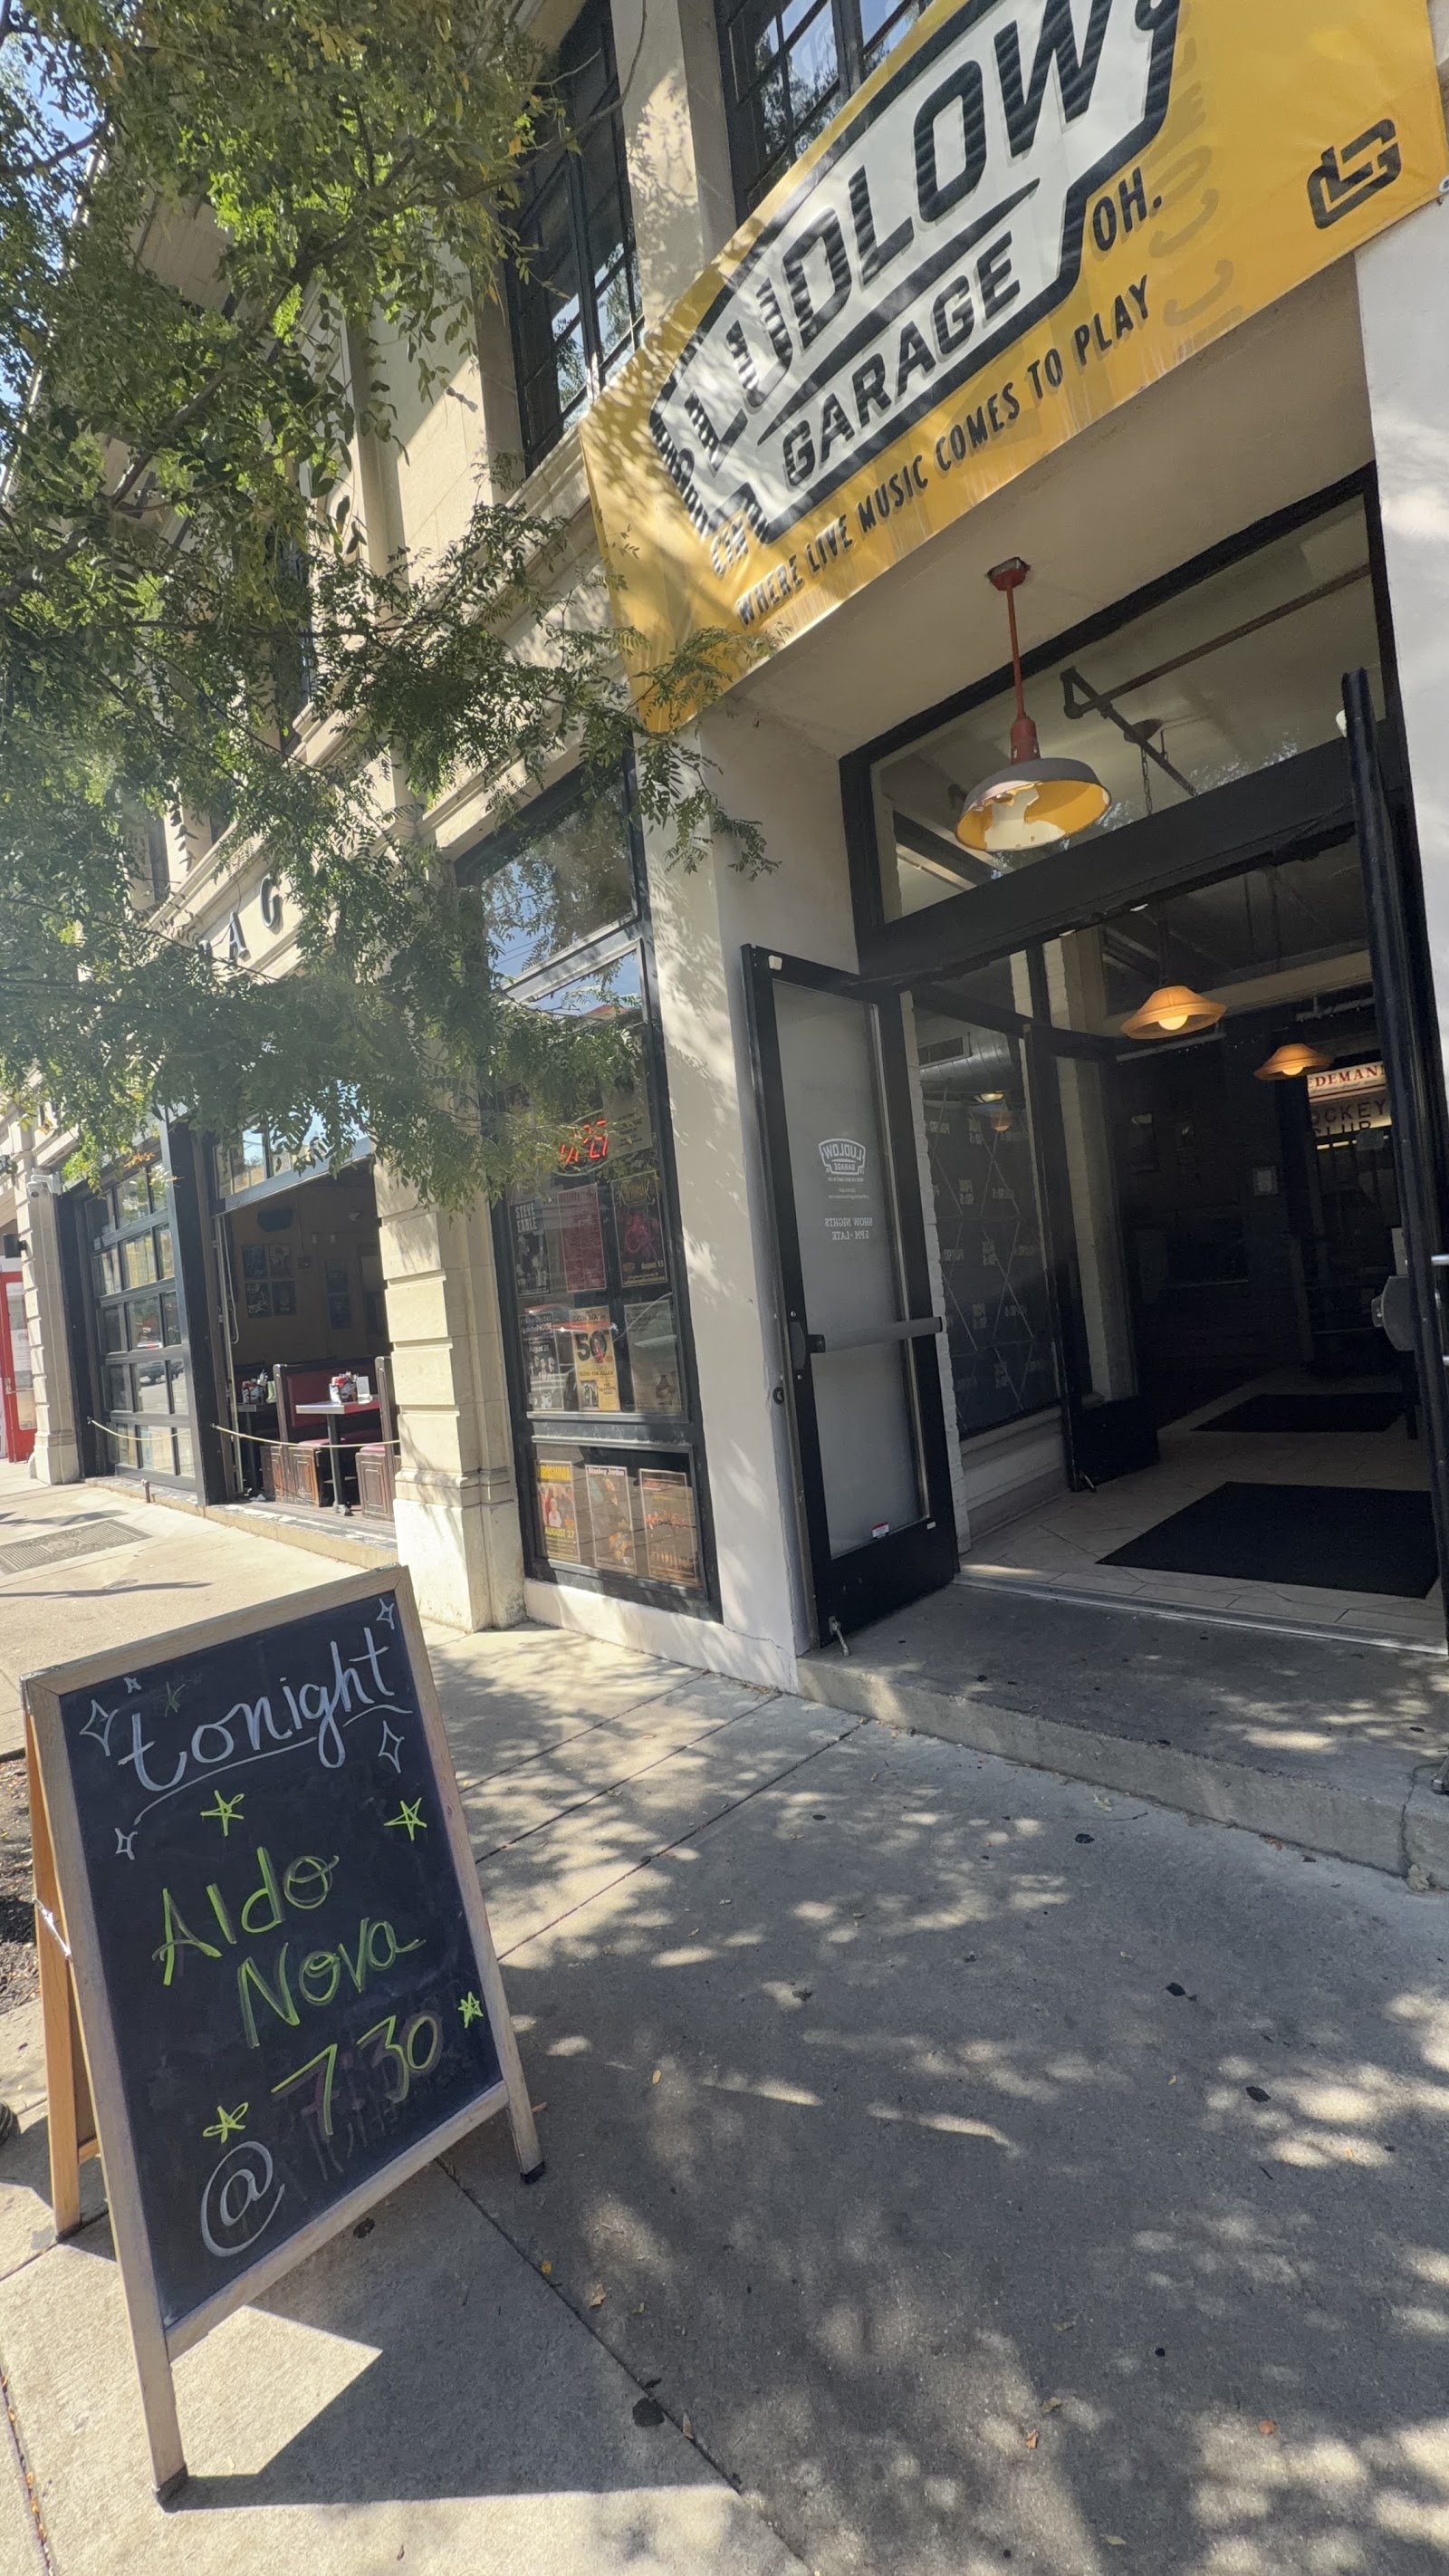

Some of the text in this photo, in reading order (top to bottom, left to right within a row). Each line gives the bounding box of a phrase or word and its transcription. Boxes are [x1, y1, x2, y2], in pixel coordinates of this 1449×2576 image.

[684, 0, 1113, 472] LUDLOW
[1091, 167, 1162, 252] OH.
[782, 231, 1021, 486] GARAGE
[735, 274, 1149, 626] WHERE LIVE MUSIC COMES TO PLAY
[514, 1202, 535, 1219] STEVE
[516, 1216, 537, 1233] EARLE
[545, 1526, 566, 1537] AUGUST
[118, 1627, 395, 1792] tonight
[152, 1846, 340, 1985] Aldo
[237, 1917, 427, 2049] Nova
